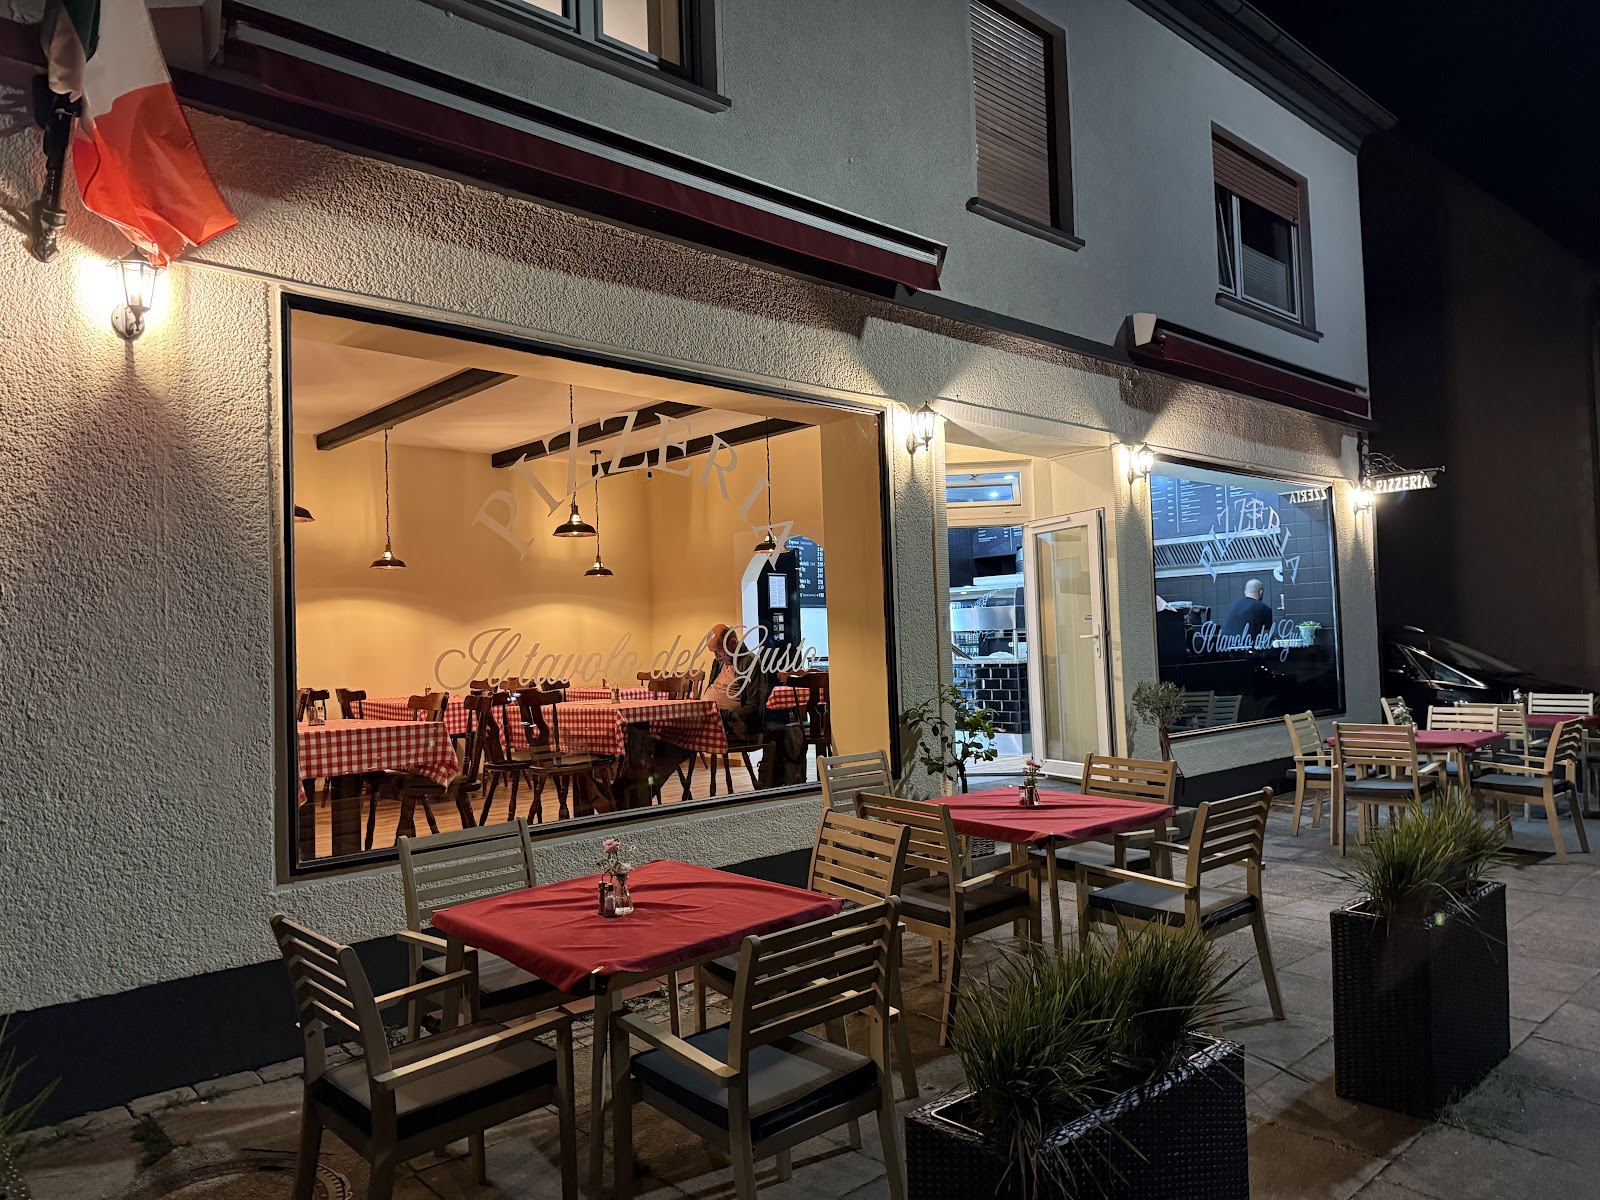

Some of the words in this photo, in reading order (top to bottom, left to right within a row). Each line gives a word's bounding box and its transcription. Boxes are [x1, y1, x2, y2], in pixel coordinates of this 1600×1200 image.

[472, 411, 793, 571] PIZZERIA
[1375, 475, 1431, 493] PIZZERIA
[1199, 498, 1300, 585] PIZZERIA
[434, 628, 522, 690] Il
[518, 631, 643, 686] tavolo
[651, 629, 715, 680] del
[723, 625, 821, 699] Gusto
[1192, 620, 1216, 654] Il
[1215, 622, 1253, 653] tavolo
[1254, 622, 1276, 650] del
